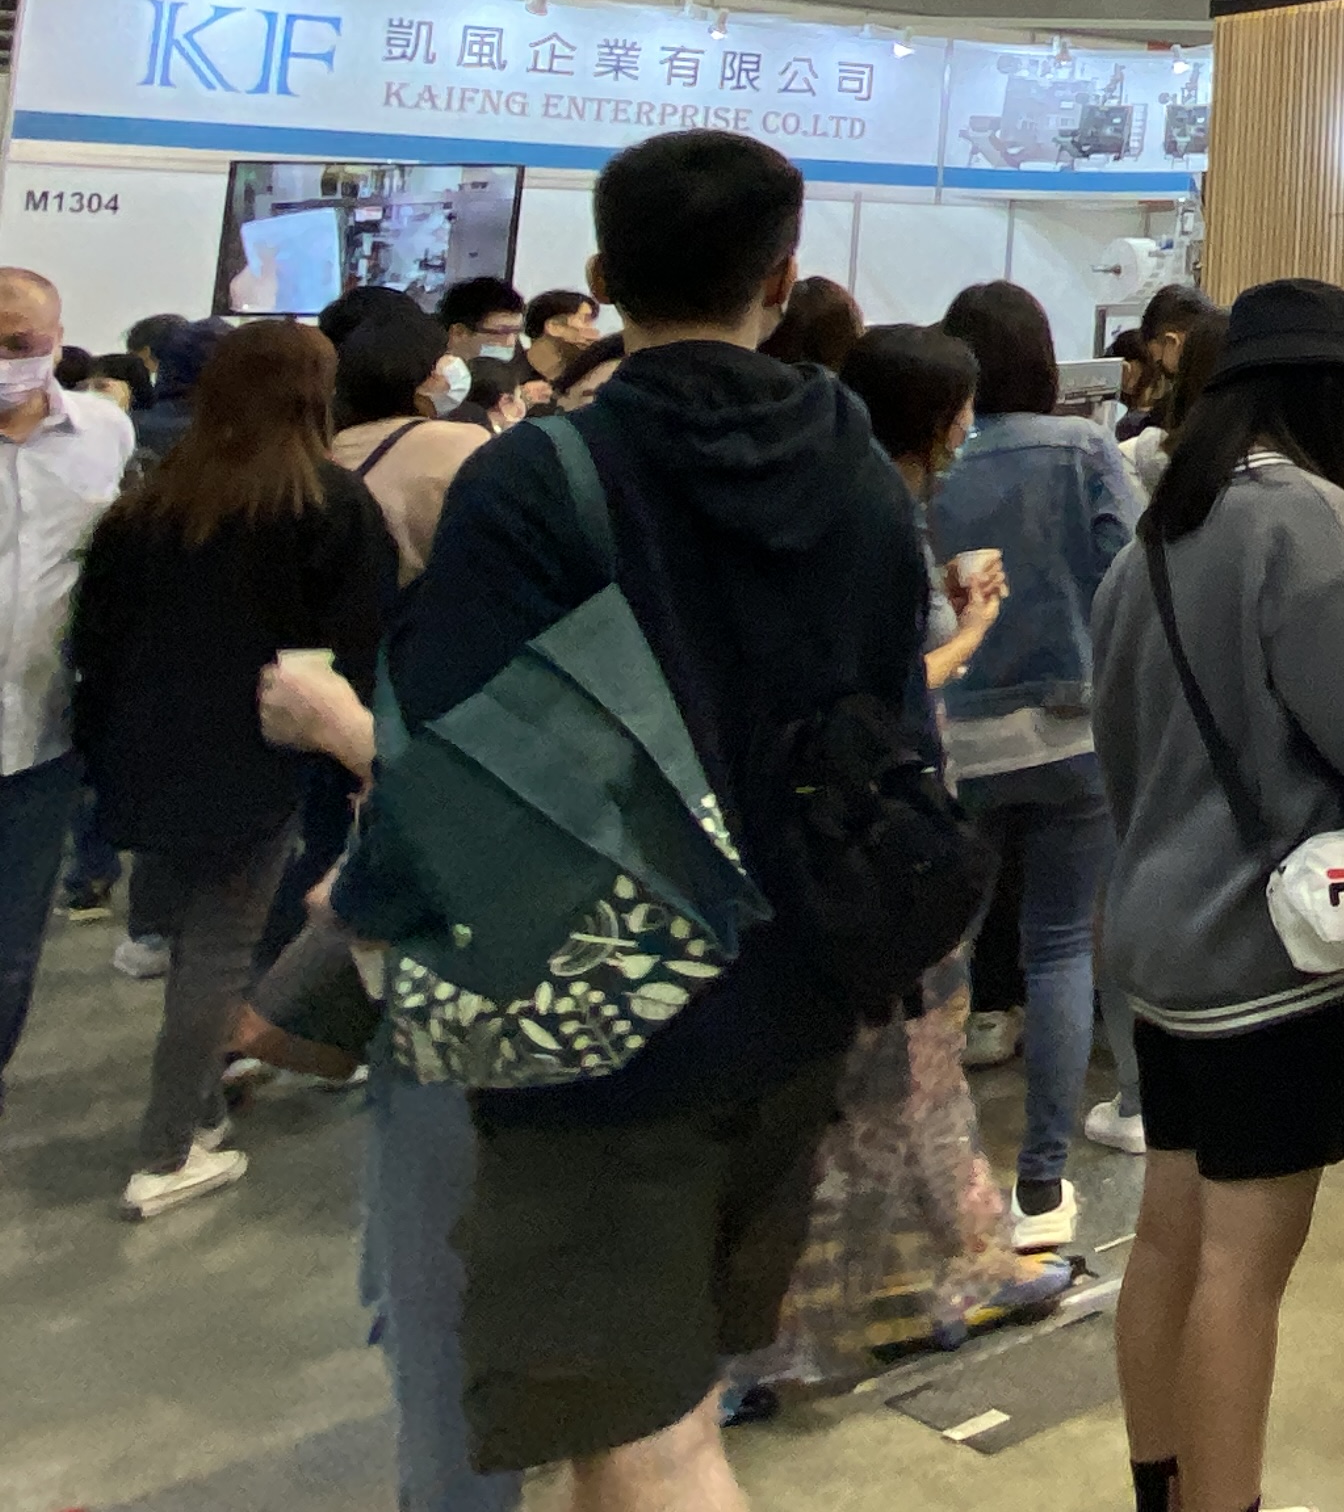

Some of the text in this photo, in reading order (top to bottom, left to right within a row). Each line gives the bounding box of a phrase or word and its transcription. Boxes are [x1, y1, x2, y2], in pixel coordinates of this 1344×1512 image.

[136, 0, 342, 97] KF
[381, 17, 876, 102] 凱風企業有限公司
[541, 94, 752, 134] ENTERPRISE
[761, 110, 867, 141] CO.LTD
[25, 189, 120, 215] M1304
